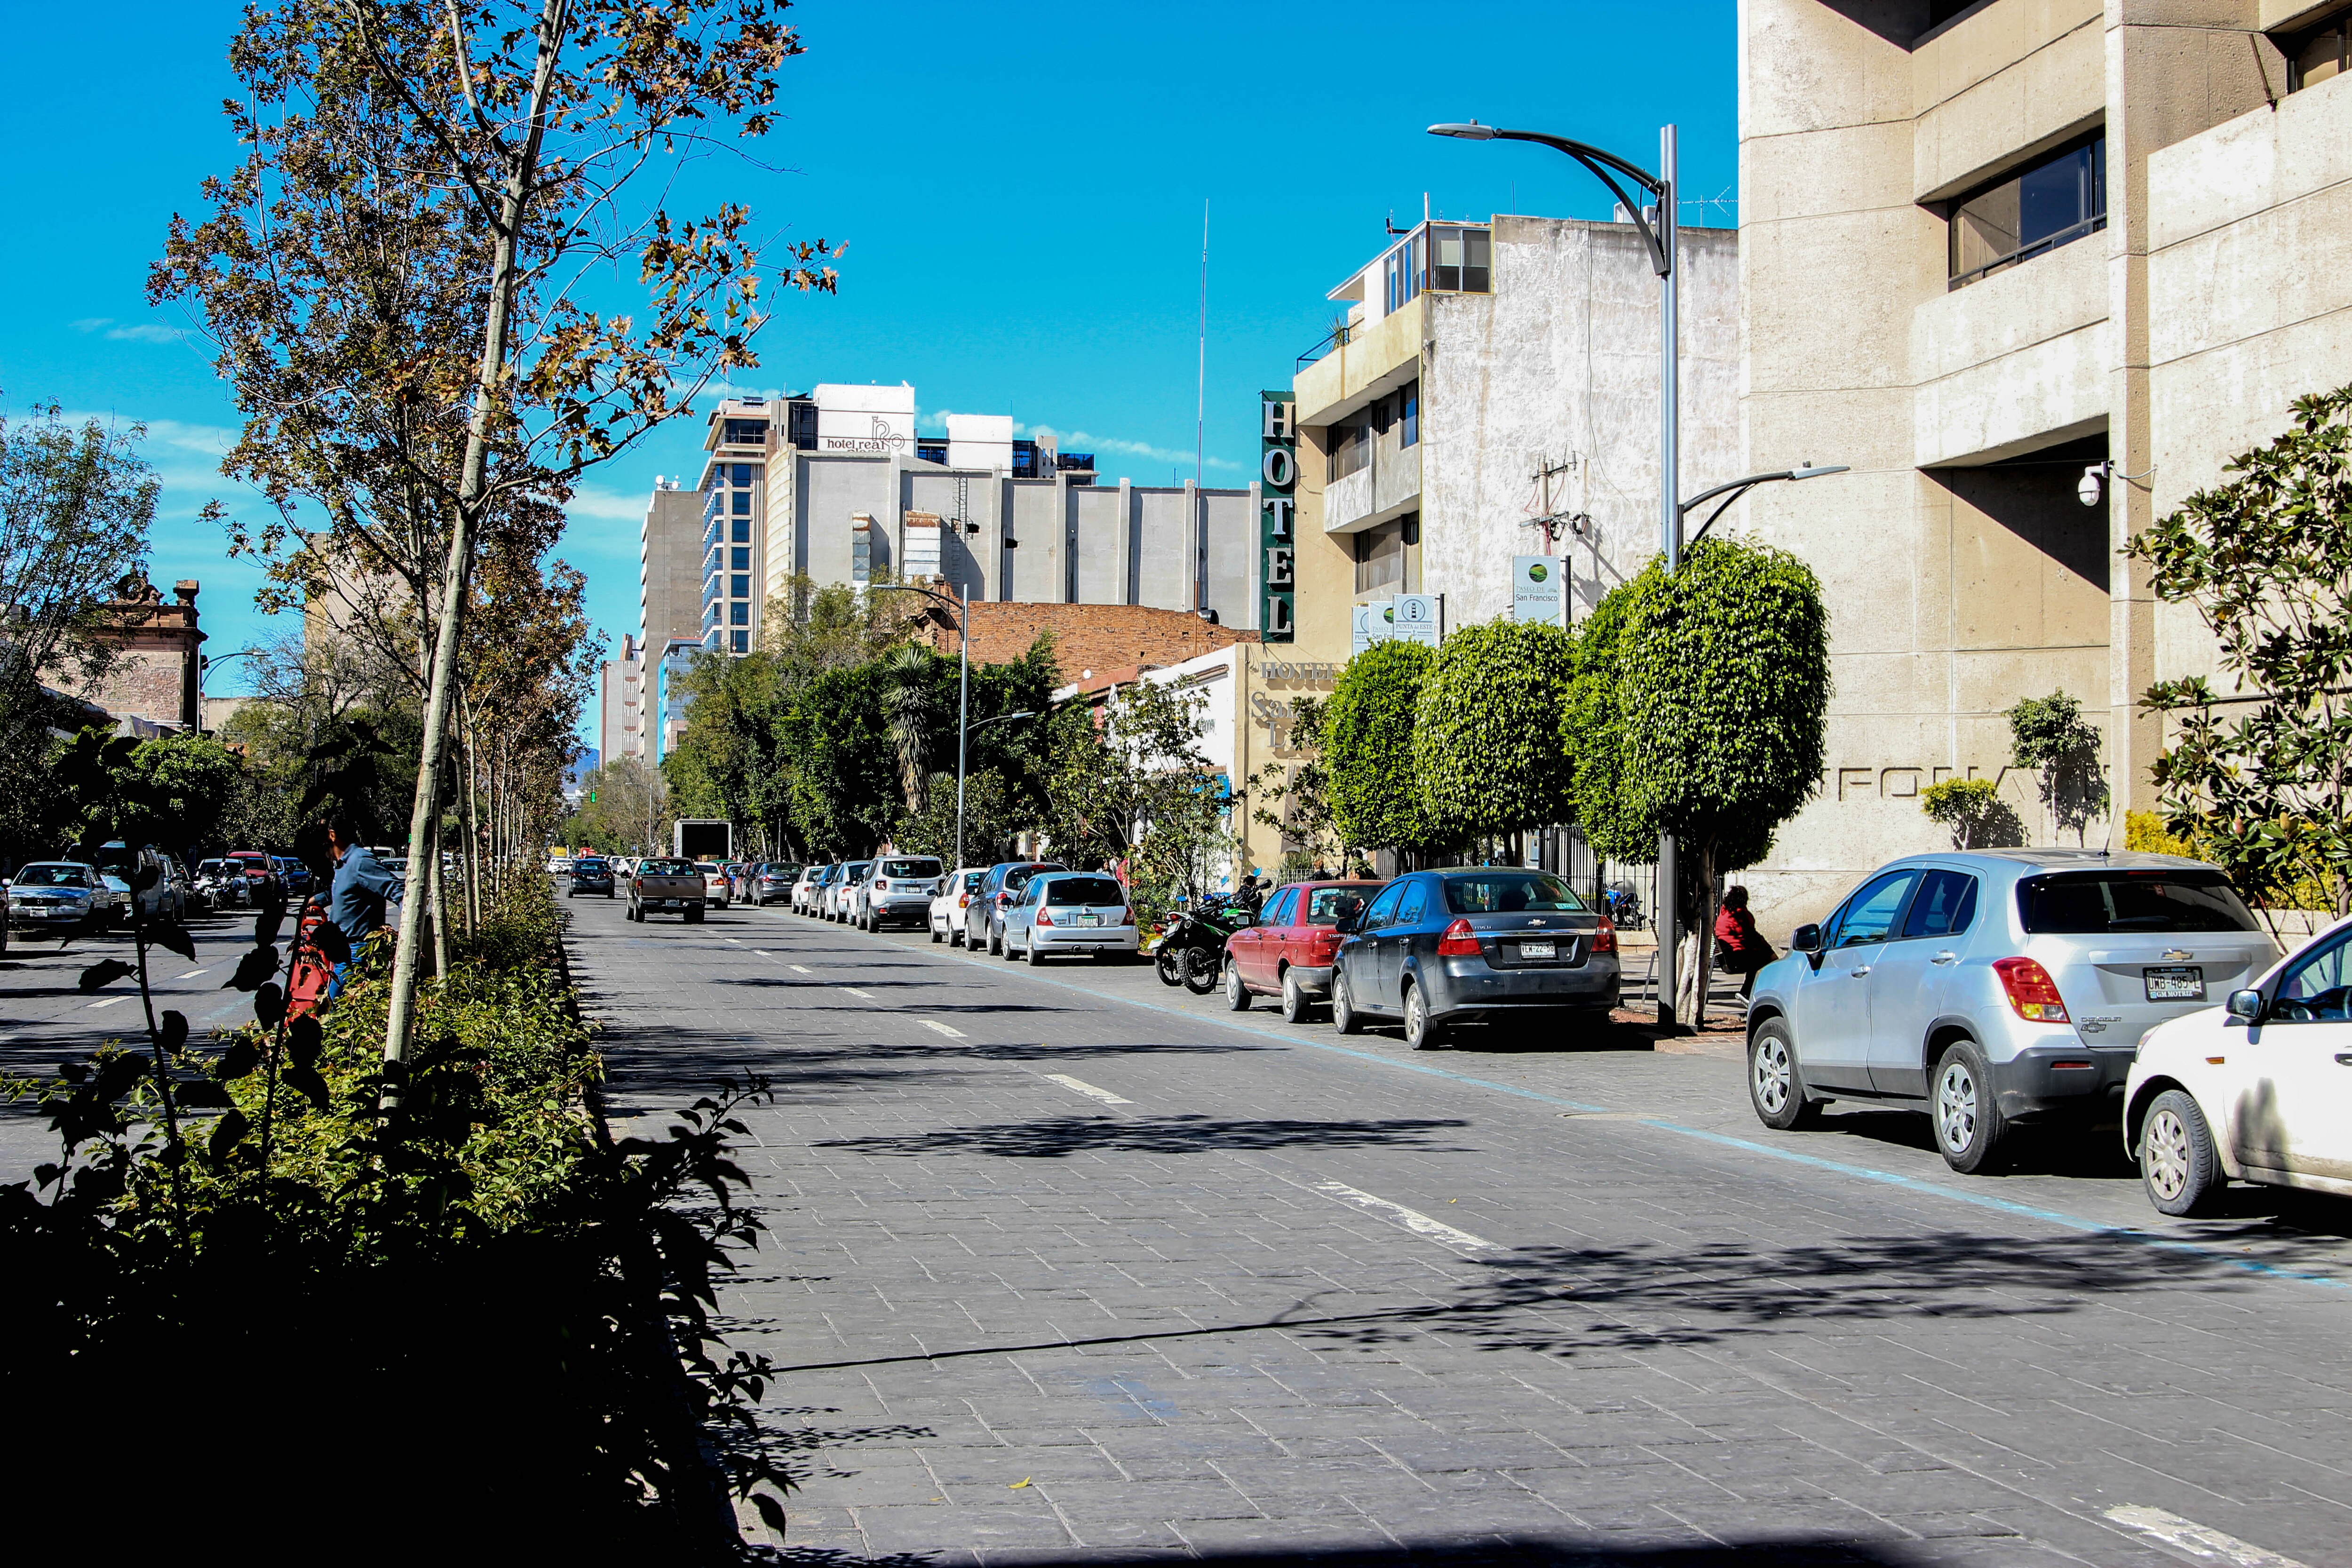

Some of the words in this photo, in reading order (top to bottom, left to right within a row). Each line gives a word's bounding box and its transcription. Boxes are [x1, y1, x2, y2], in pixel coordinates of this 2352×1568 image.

[827, 438, 855, 449] hotel
[857, 440, 885, 450] real
[1263, 401, 1295, 633] HOTEL
[1260, 662, 1338, 680] HOTEL
